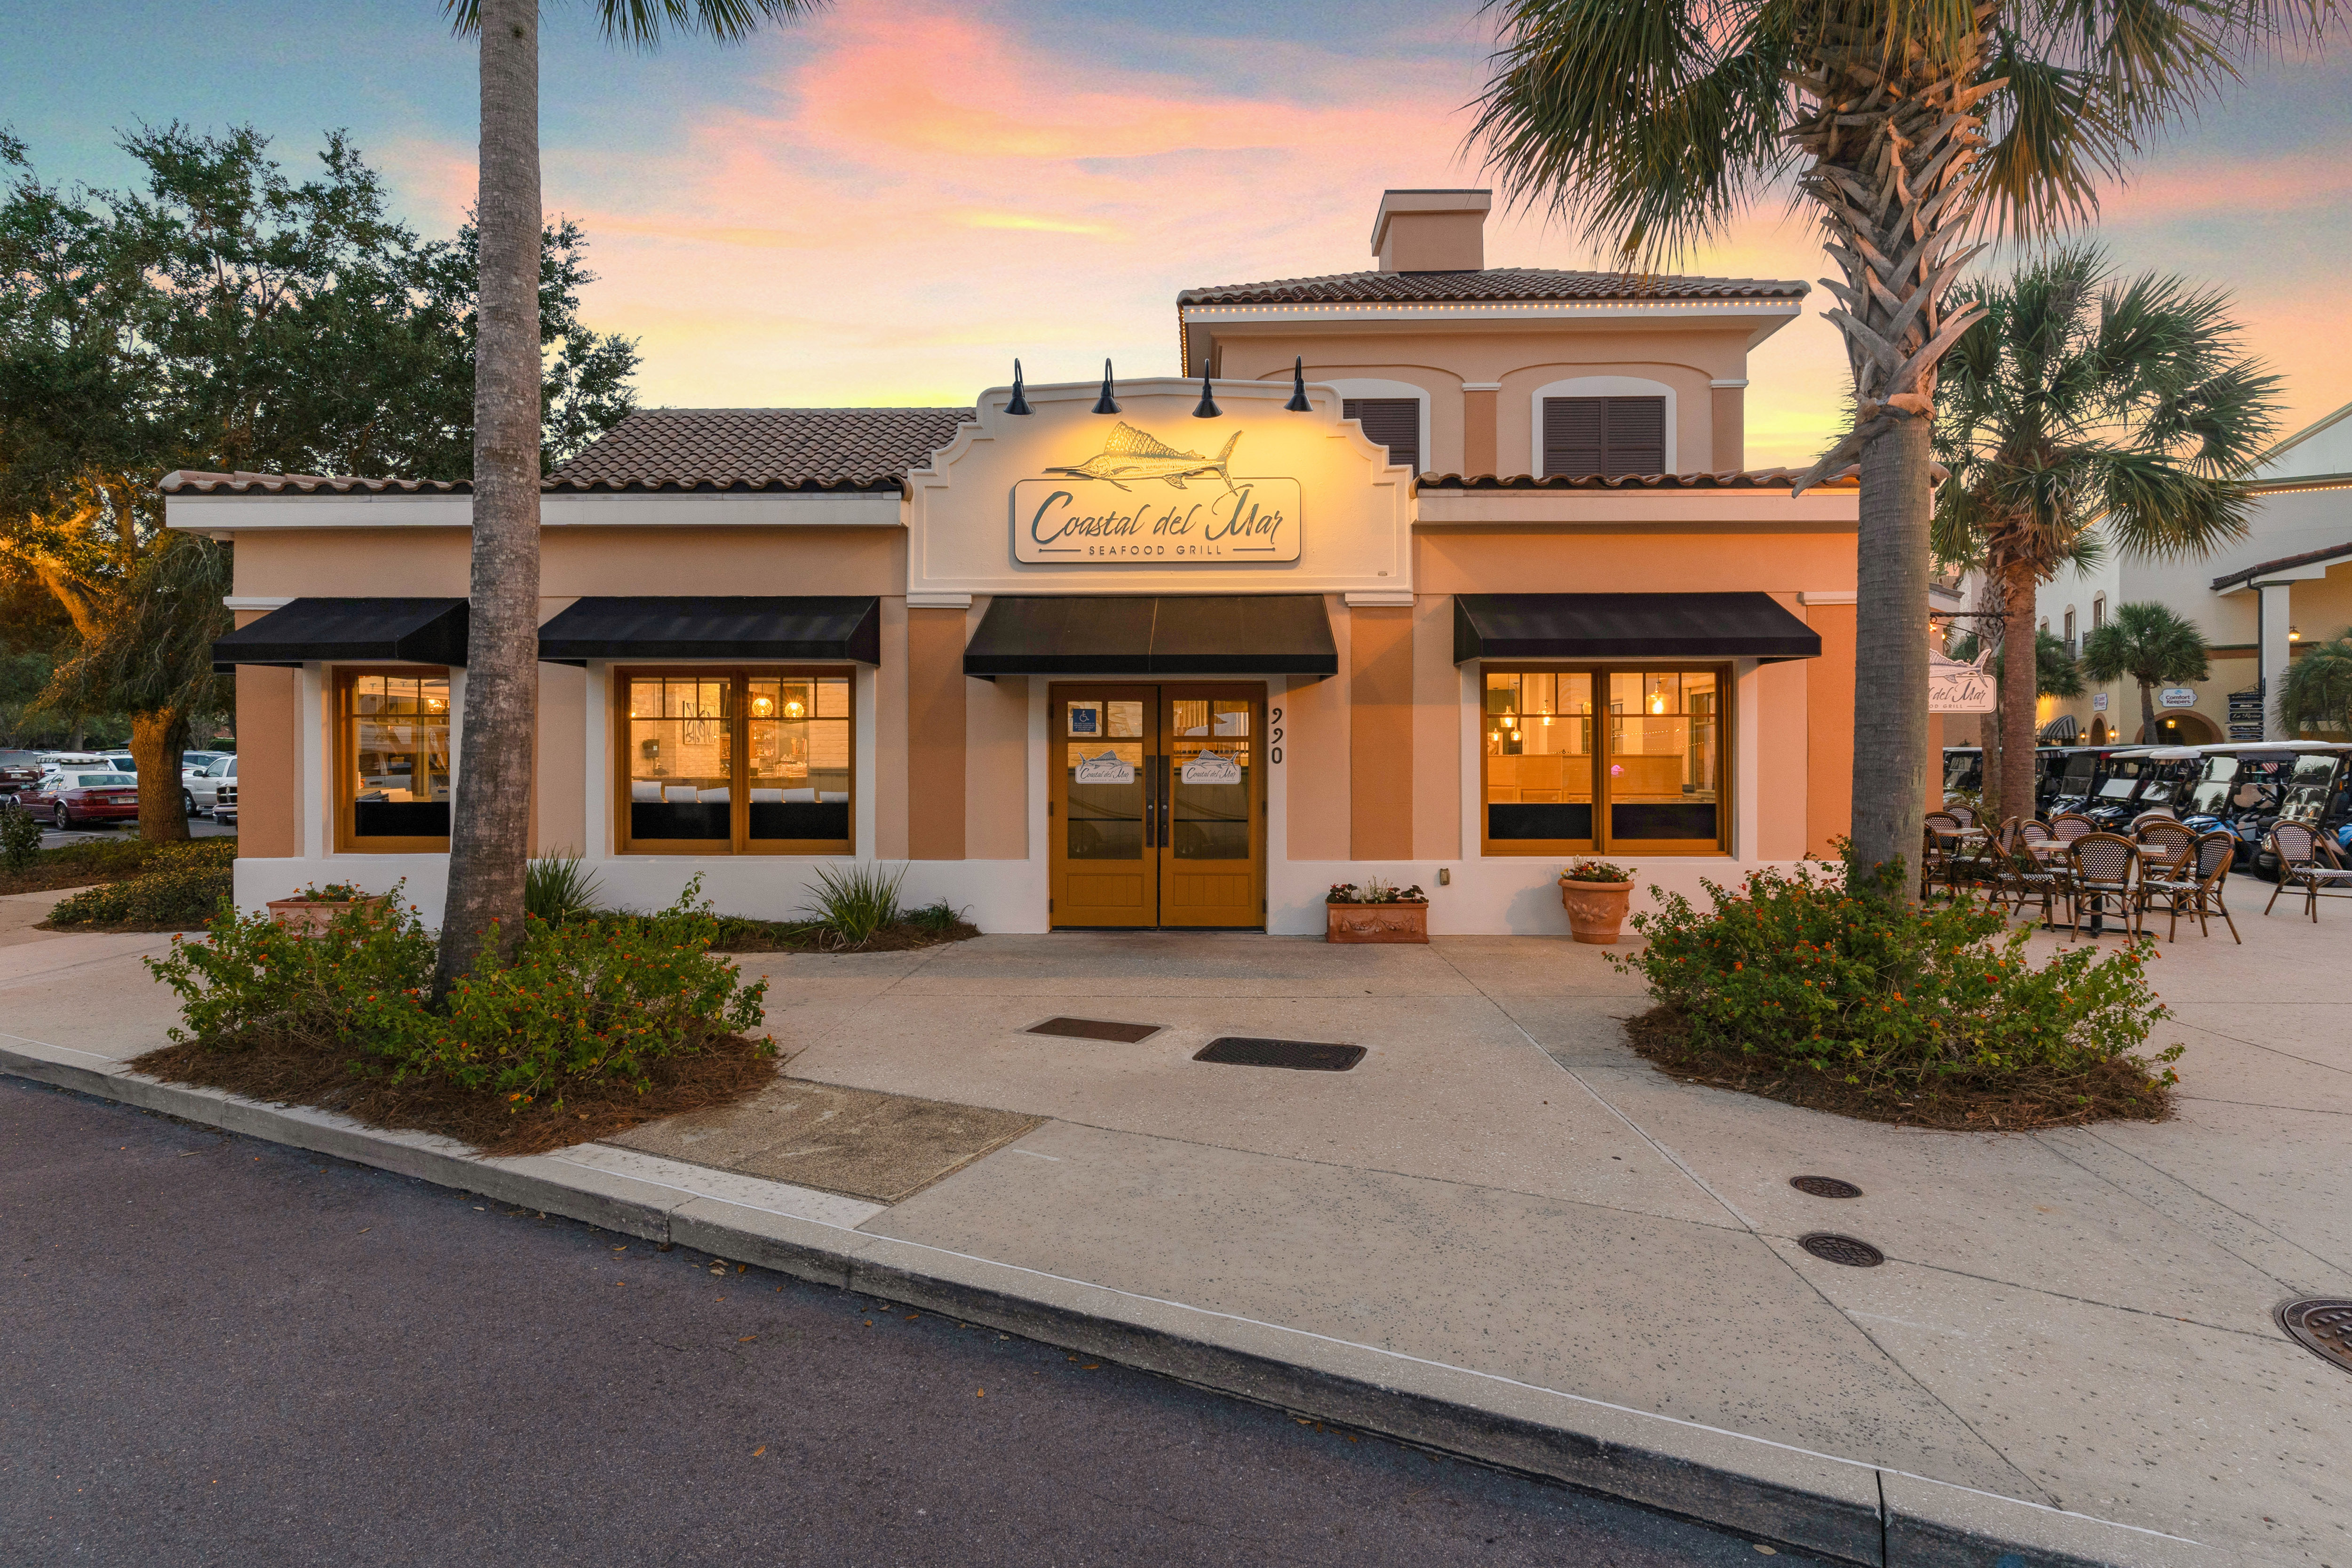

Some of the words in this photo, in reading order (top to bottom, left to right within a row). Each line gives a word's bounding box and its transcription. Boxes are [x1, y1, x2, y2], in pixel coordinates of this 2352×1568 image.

[1032, 491, 1151, 544] Coastal
[1153, 503, 1202, 535] del
[1205, 483, 1283, 544] Mar
[1089, 545, 1165, 555] SEAFOOD
[1176, 545, 1222, 555] GRILL
[1932, 686, 1954, 700] del
[1952, 678, 1986, 704] Mar
[1271, 708, 1284, 764] 990
[1081, 768, 1105, 779] Coastal
[1113, 766, 1129, 780] Mar
[1186, 767, 1212, 779] Coastal
[1219, 766, 1236, 779] Mar
